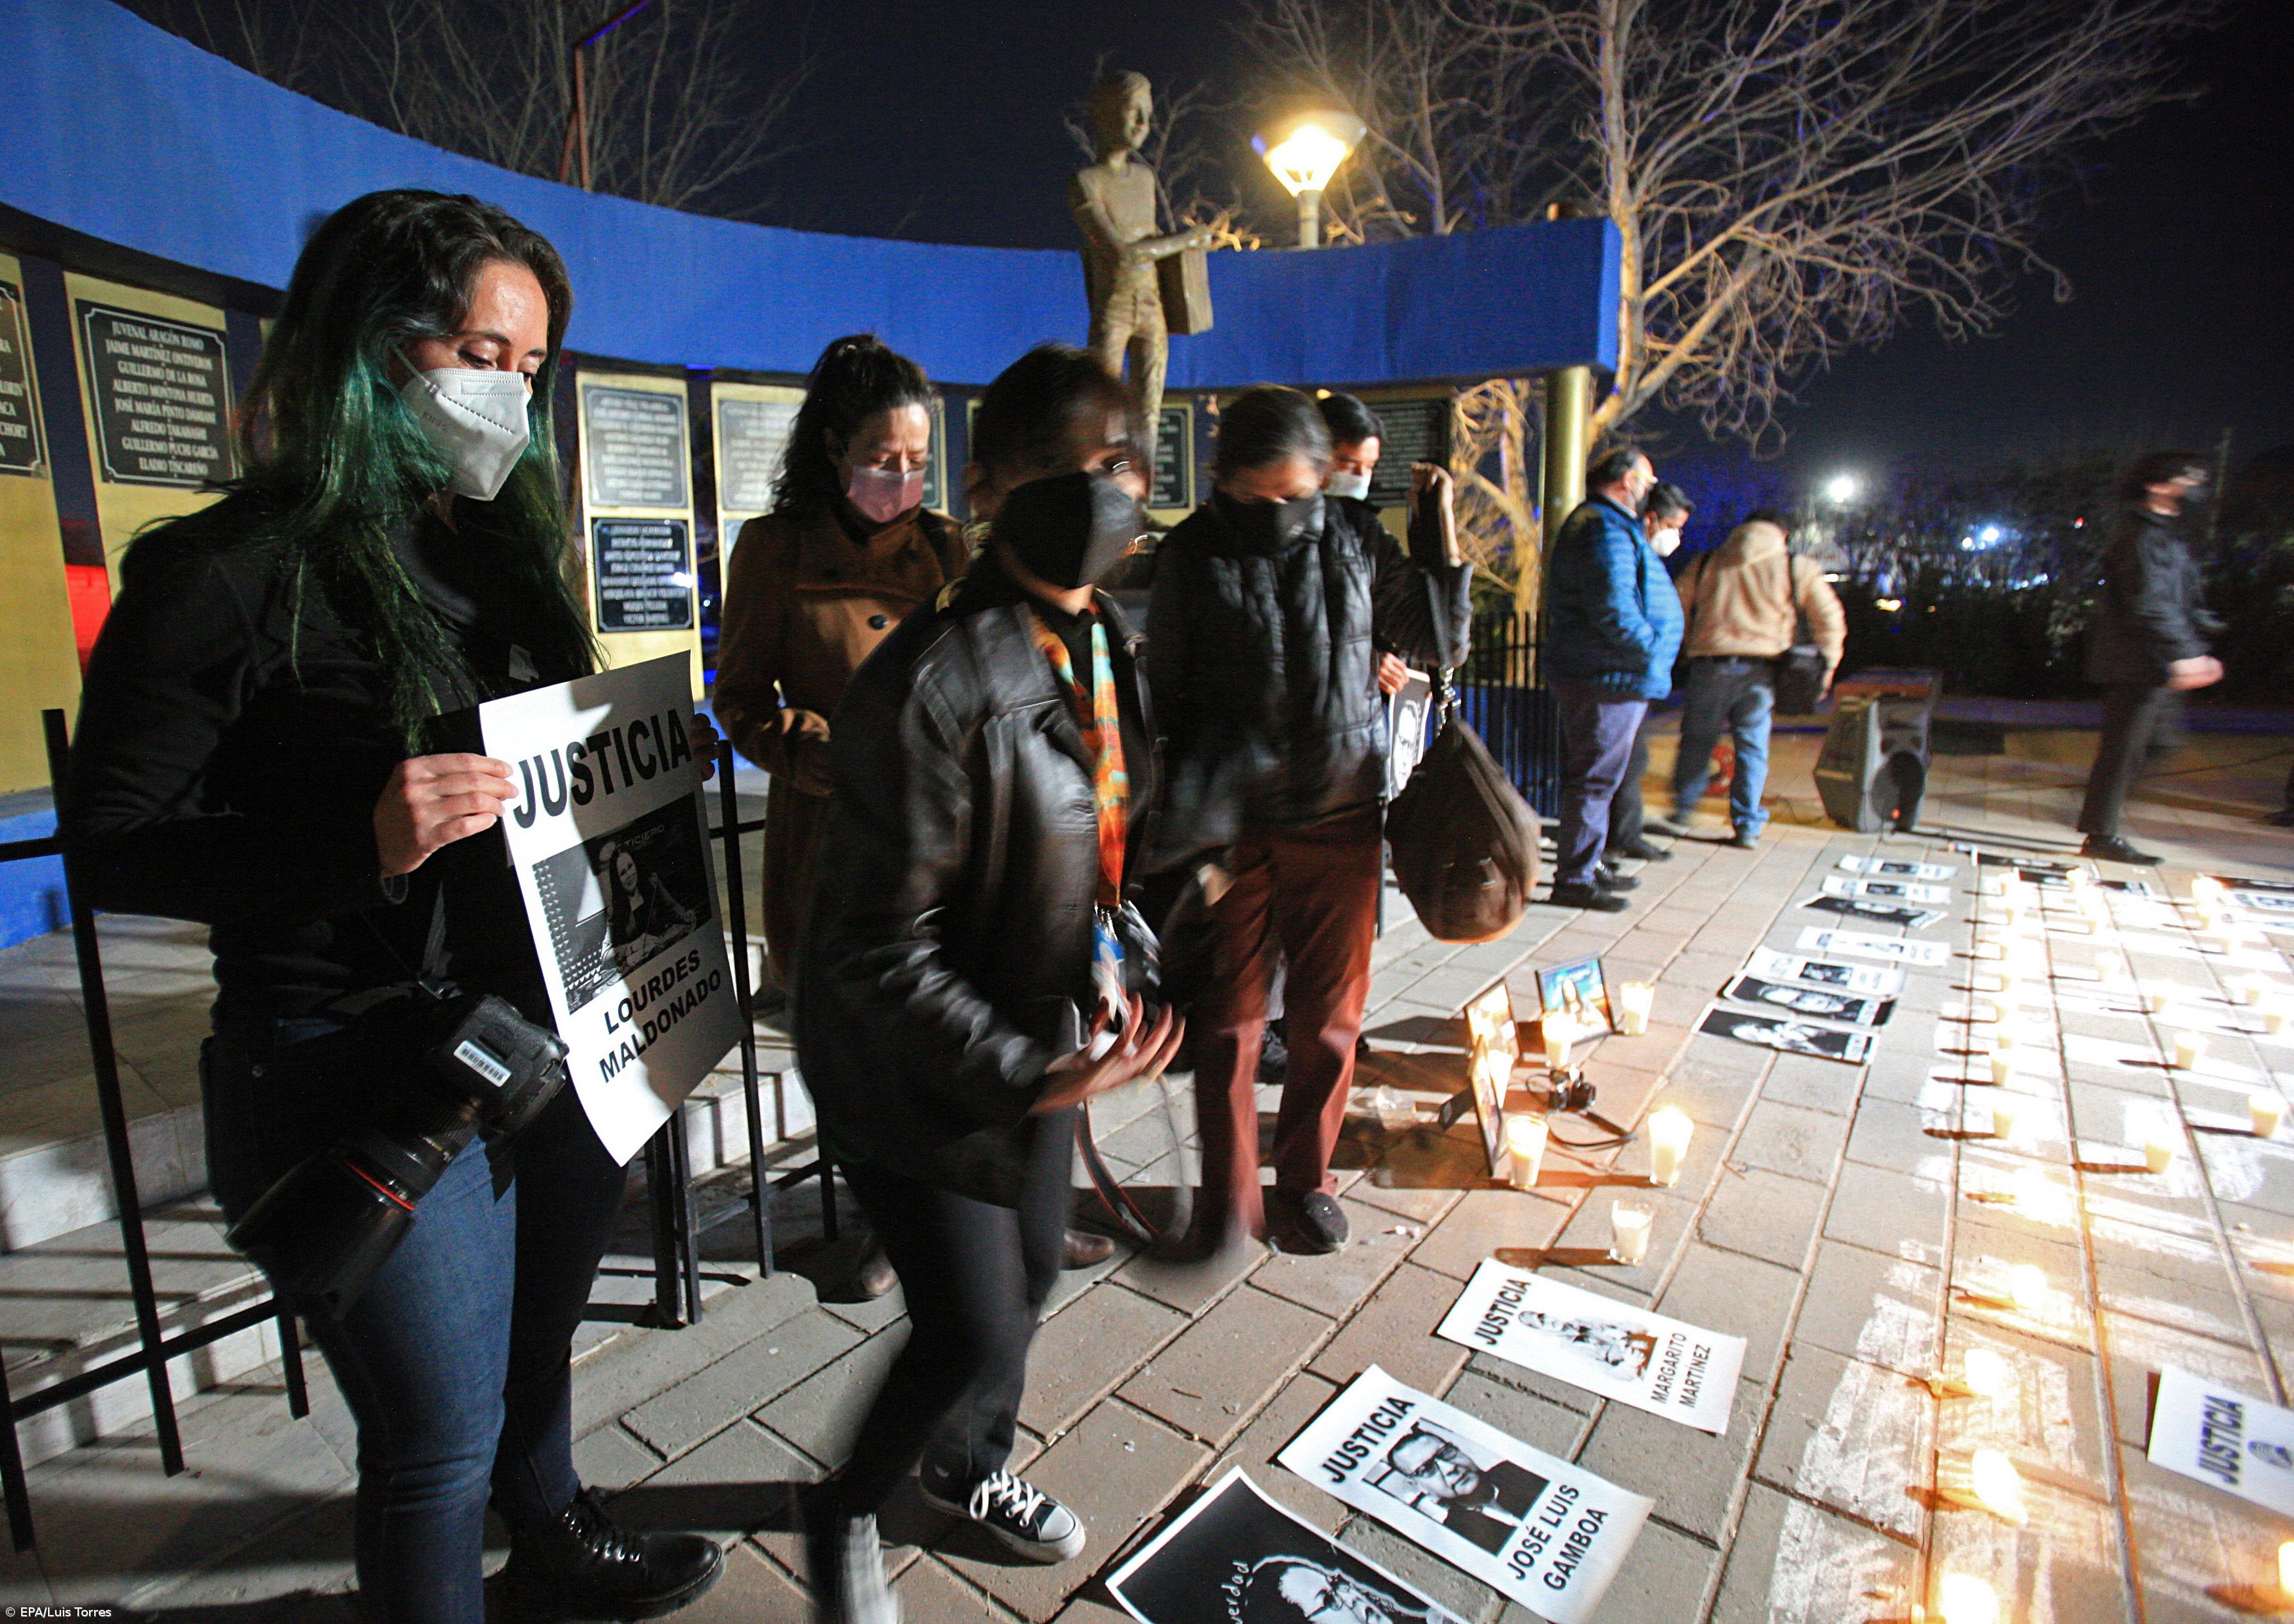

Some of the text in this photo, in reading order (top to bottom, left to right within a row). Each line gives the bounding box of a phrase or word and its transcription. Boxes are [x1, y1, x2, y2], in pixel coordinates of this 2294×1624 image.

[513, 709, 692, 829] JUSTICIA
[598, 969, 722, 1084] MALDONADO
[604, 950, 700, 1035] LOURDES
[1474, 1278, 1532, 1345] JUSTICIA
[1651, 1333, 1687, 1404] MARGARITO
[1679, 1344, 1712, 1408] MARTÍNEZ
[1320, 1397, 1415, 1484] JUSTICIA
[2198, 1395, 2243, 1484] JUSTICIA
[1506, 1484, 1580, 1580] JOSÉ LUIS
[1544, 1507, 1608, 1591] GAMBOA
